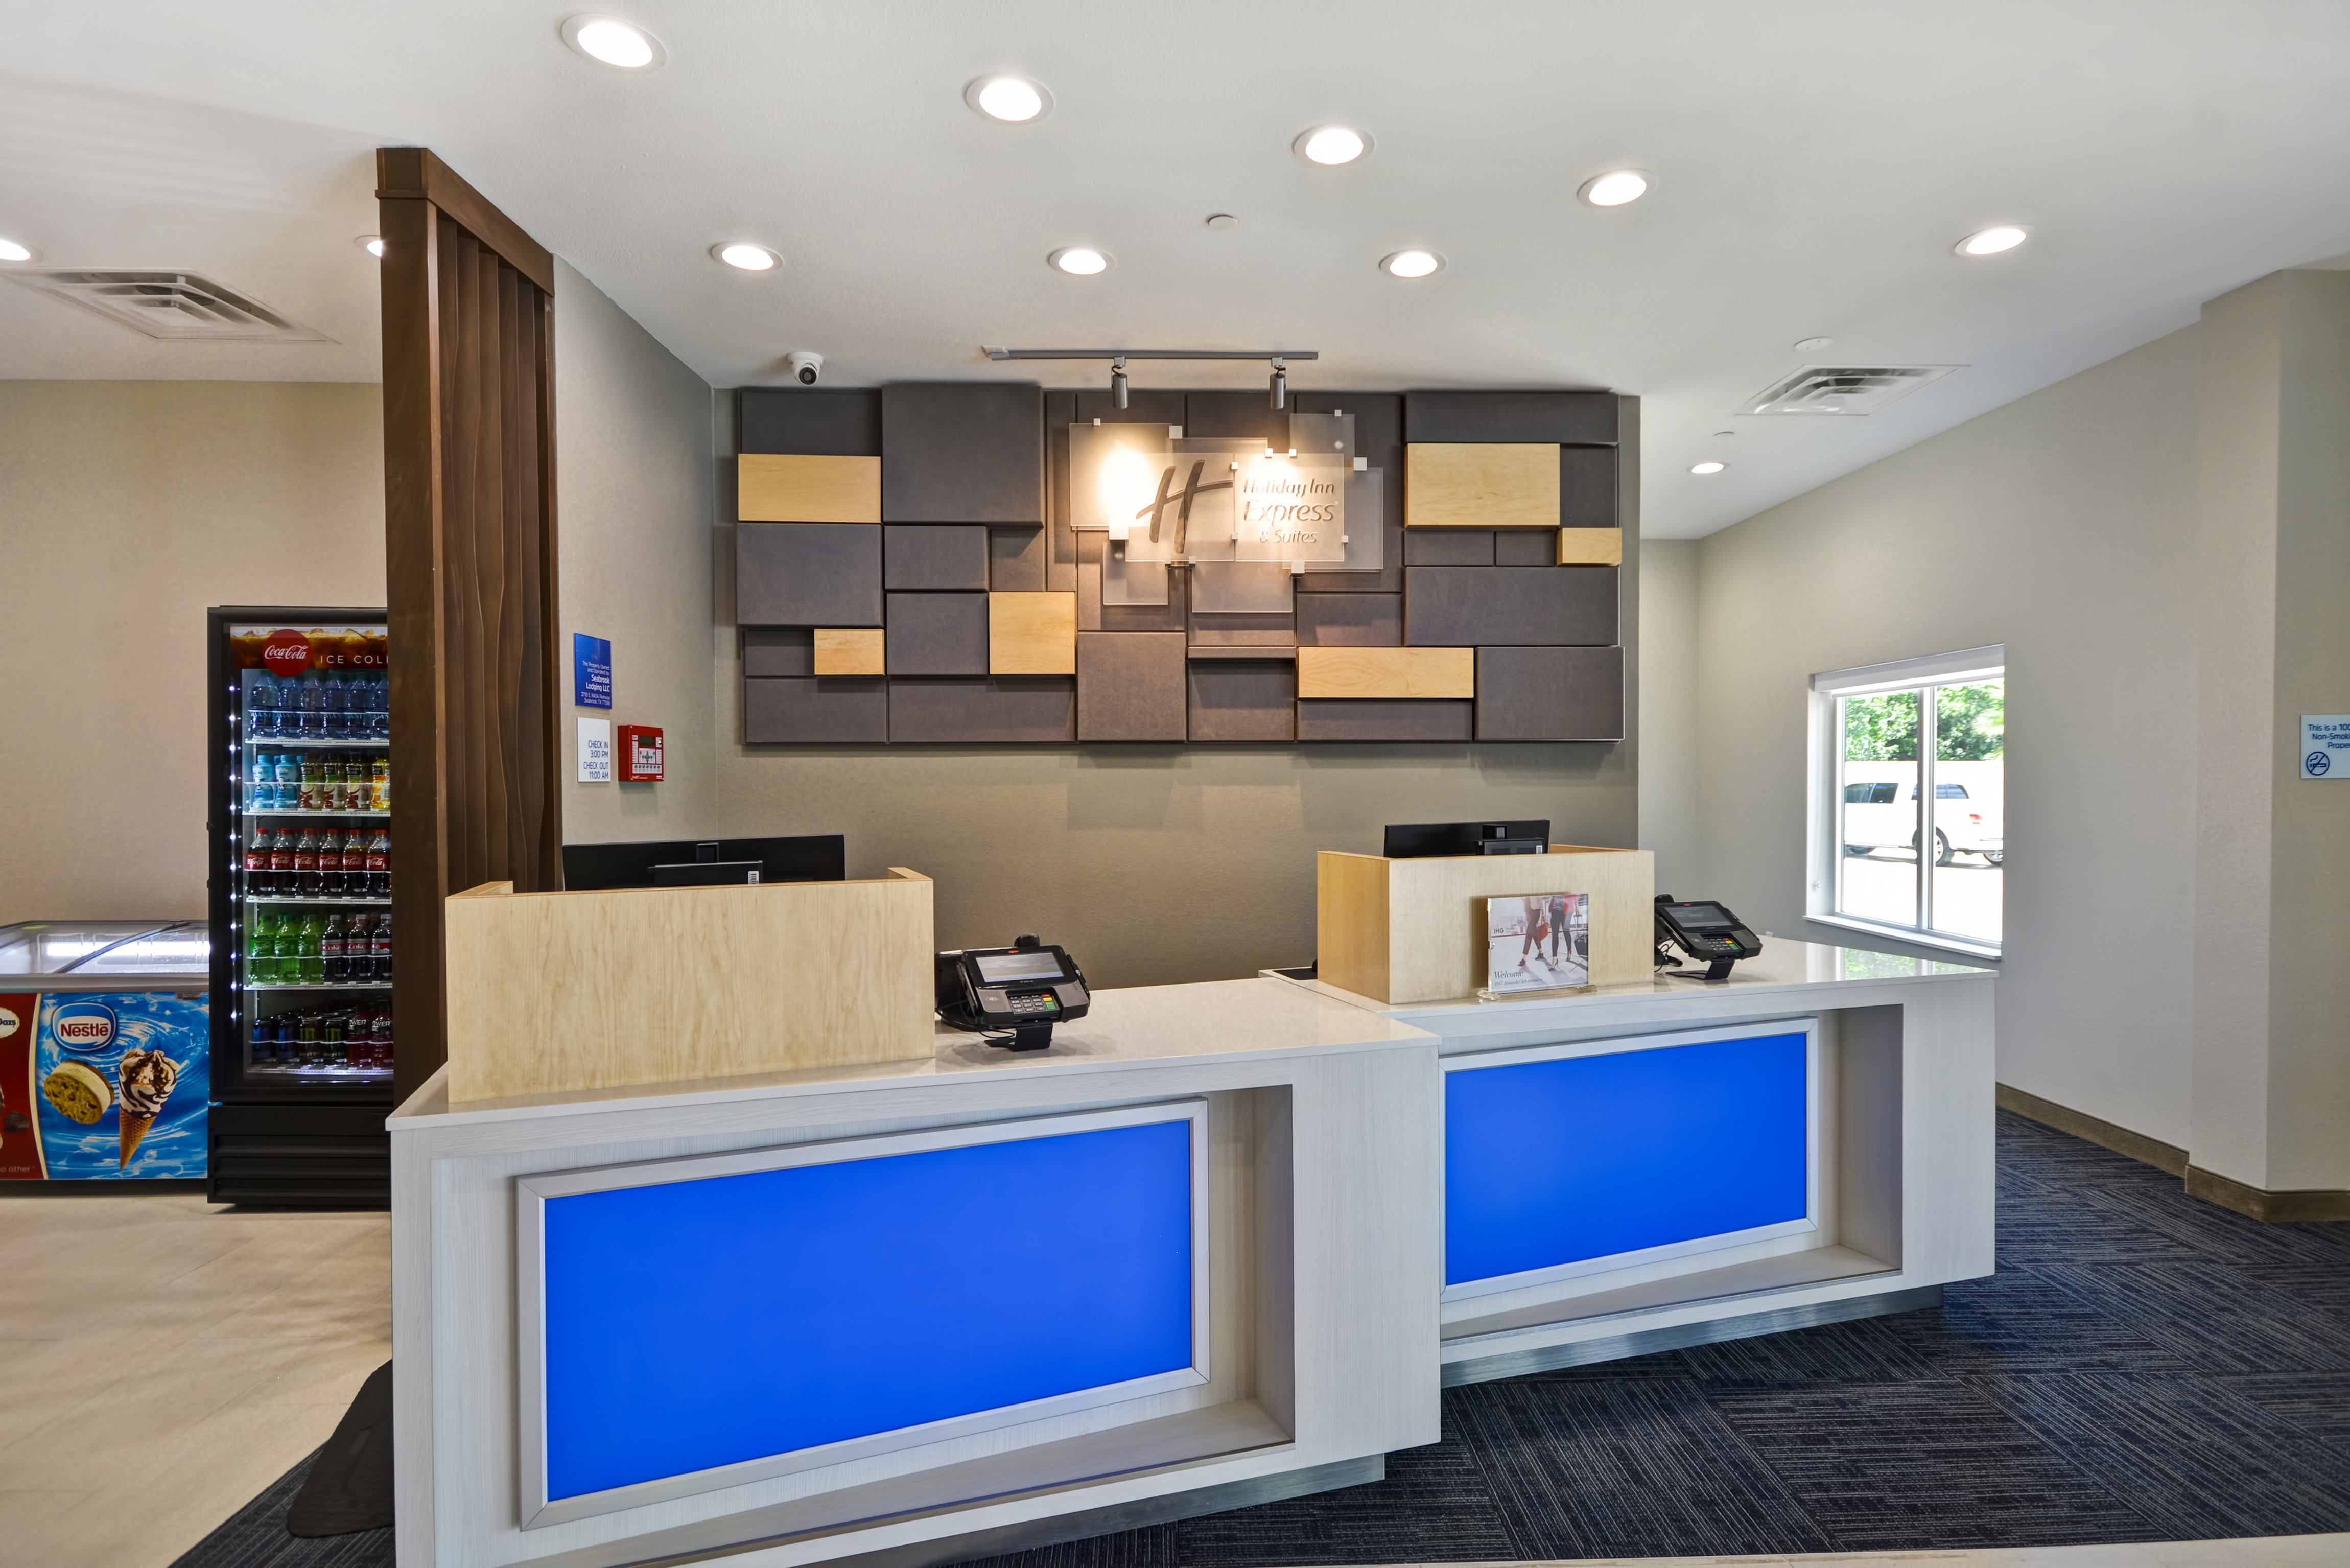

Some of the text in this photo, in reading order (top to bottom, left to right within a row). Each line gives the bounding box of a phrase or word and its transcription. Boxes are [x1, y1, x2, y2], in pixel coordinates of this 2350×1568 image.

[1243, 478, 1335, 498] Holiday Inn
[1243, 499, 1335, 527] Express
[1260, 529, 1318, 543] & Suites
[265, 645, 309, 660] Coca-Cola
[320, 655, 345, 664] ICE
[591, 674, 610, 684] Seabrook
[586, 682, 603, 692] Lodging
[588, 740, 602, 748] CHECK
[591, 750, 608, 758] 3:00 PM
[583, 761, 598, 769] CHECK
[1494, 971, 1523, 979] Welcome
[61, 1023, 109, 1037] Nestlé
